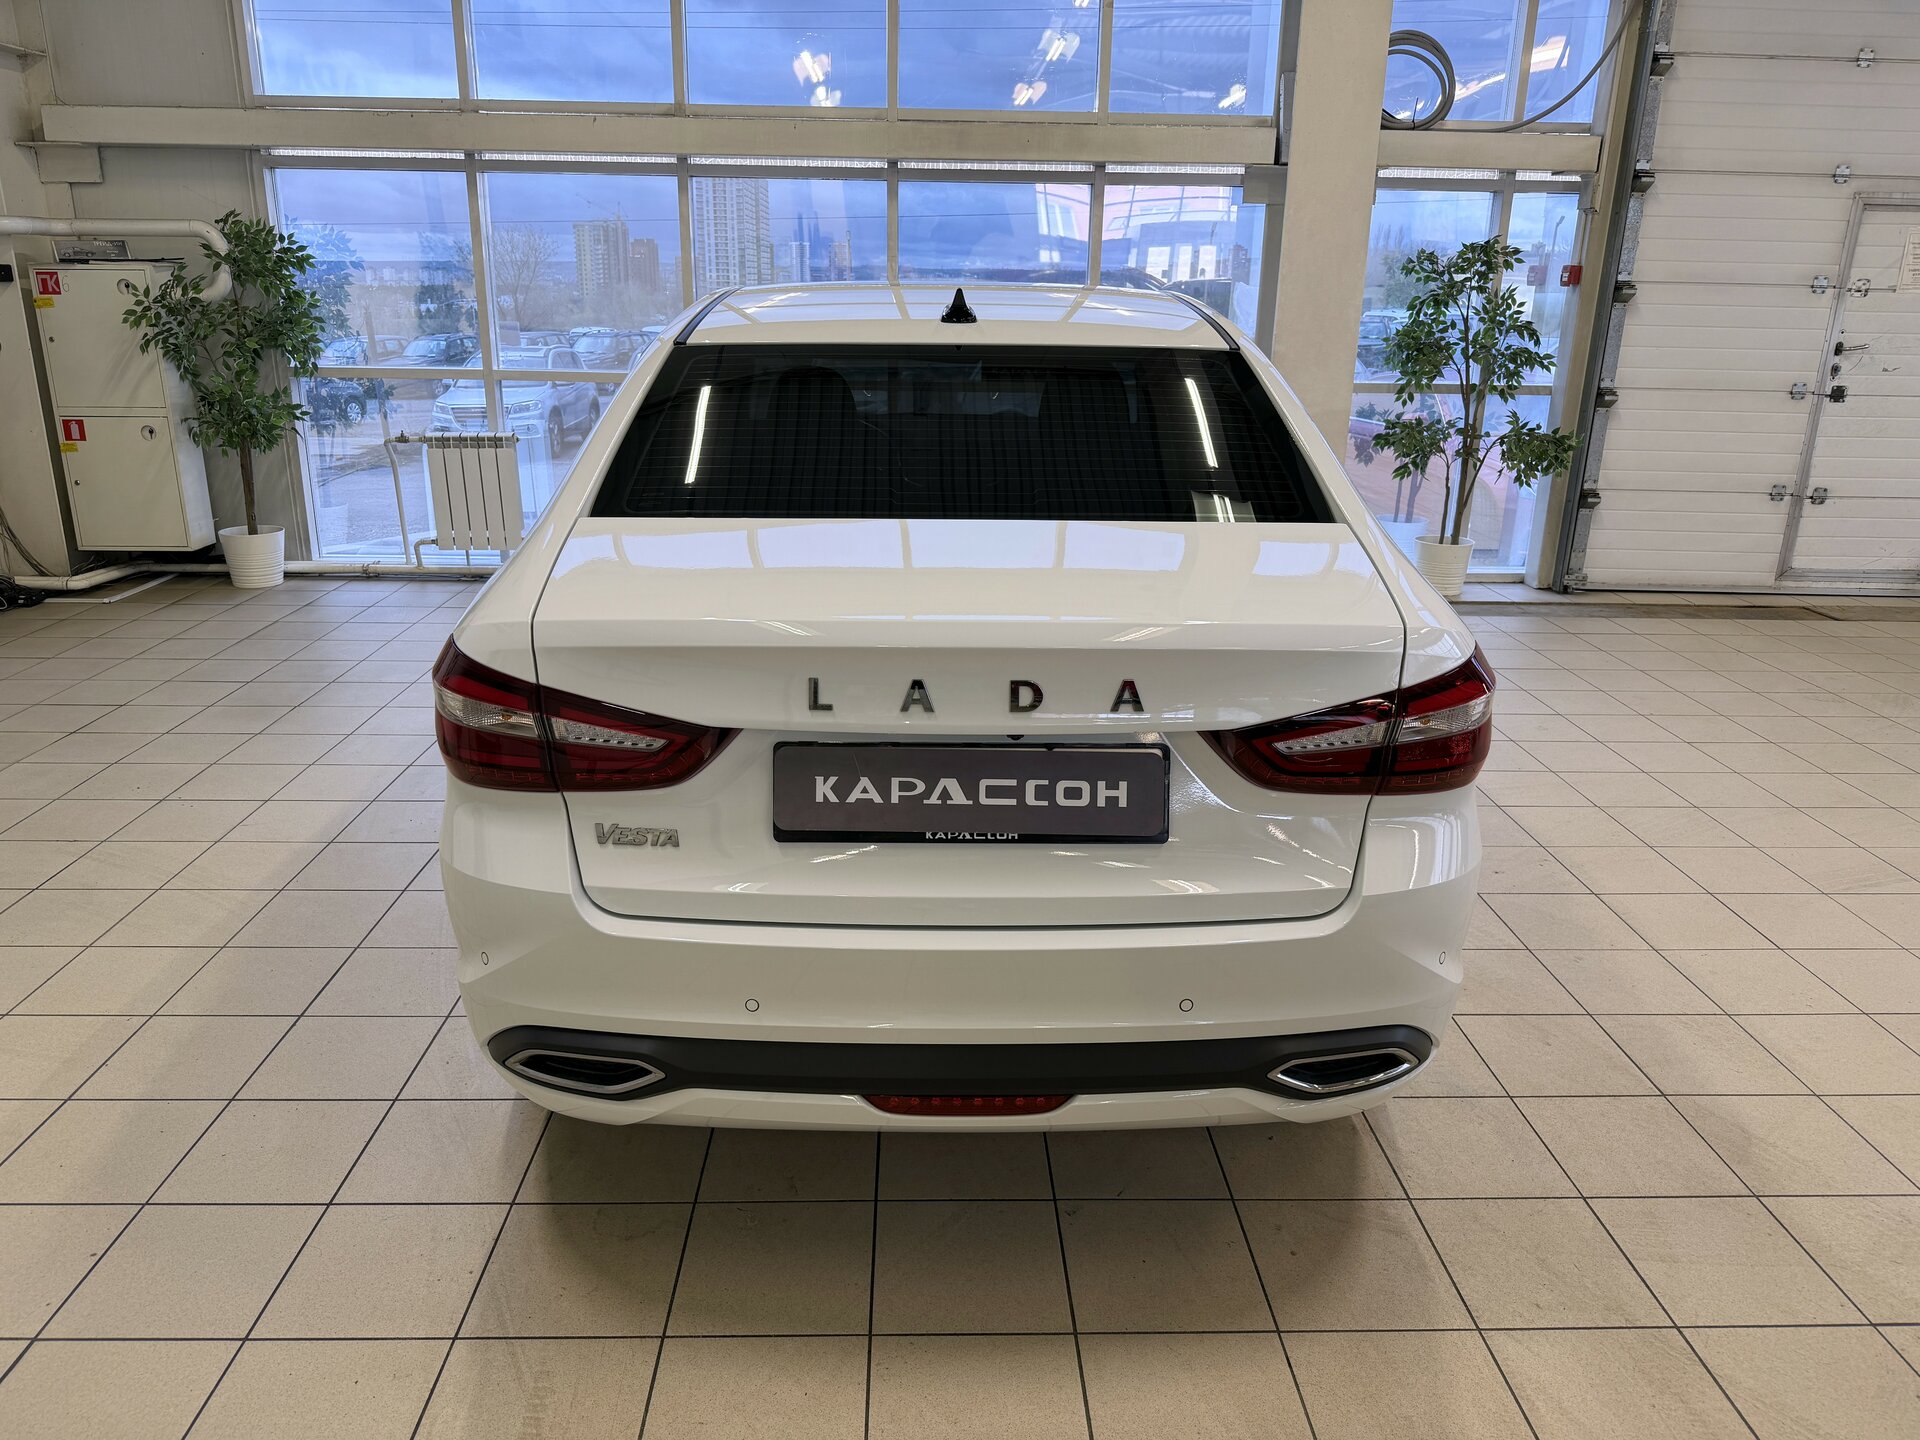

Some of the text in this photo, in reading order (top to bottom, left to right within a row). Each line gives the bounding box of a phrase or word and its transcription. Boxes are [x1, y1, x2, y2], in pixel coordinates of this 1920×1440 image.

[36, 274, 60, 292] ПК
[808, 677, 1145, 712] LADA
[594, 822, 680, 847] VESTA
